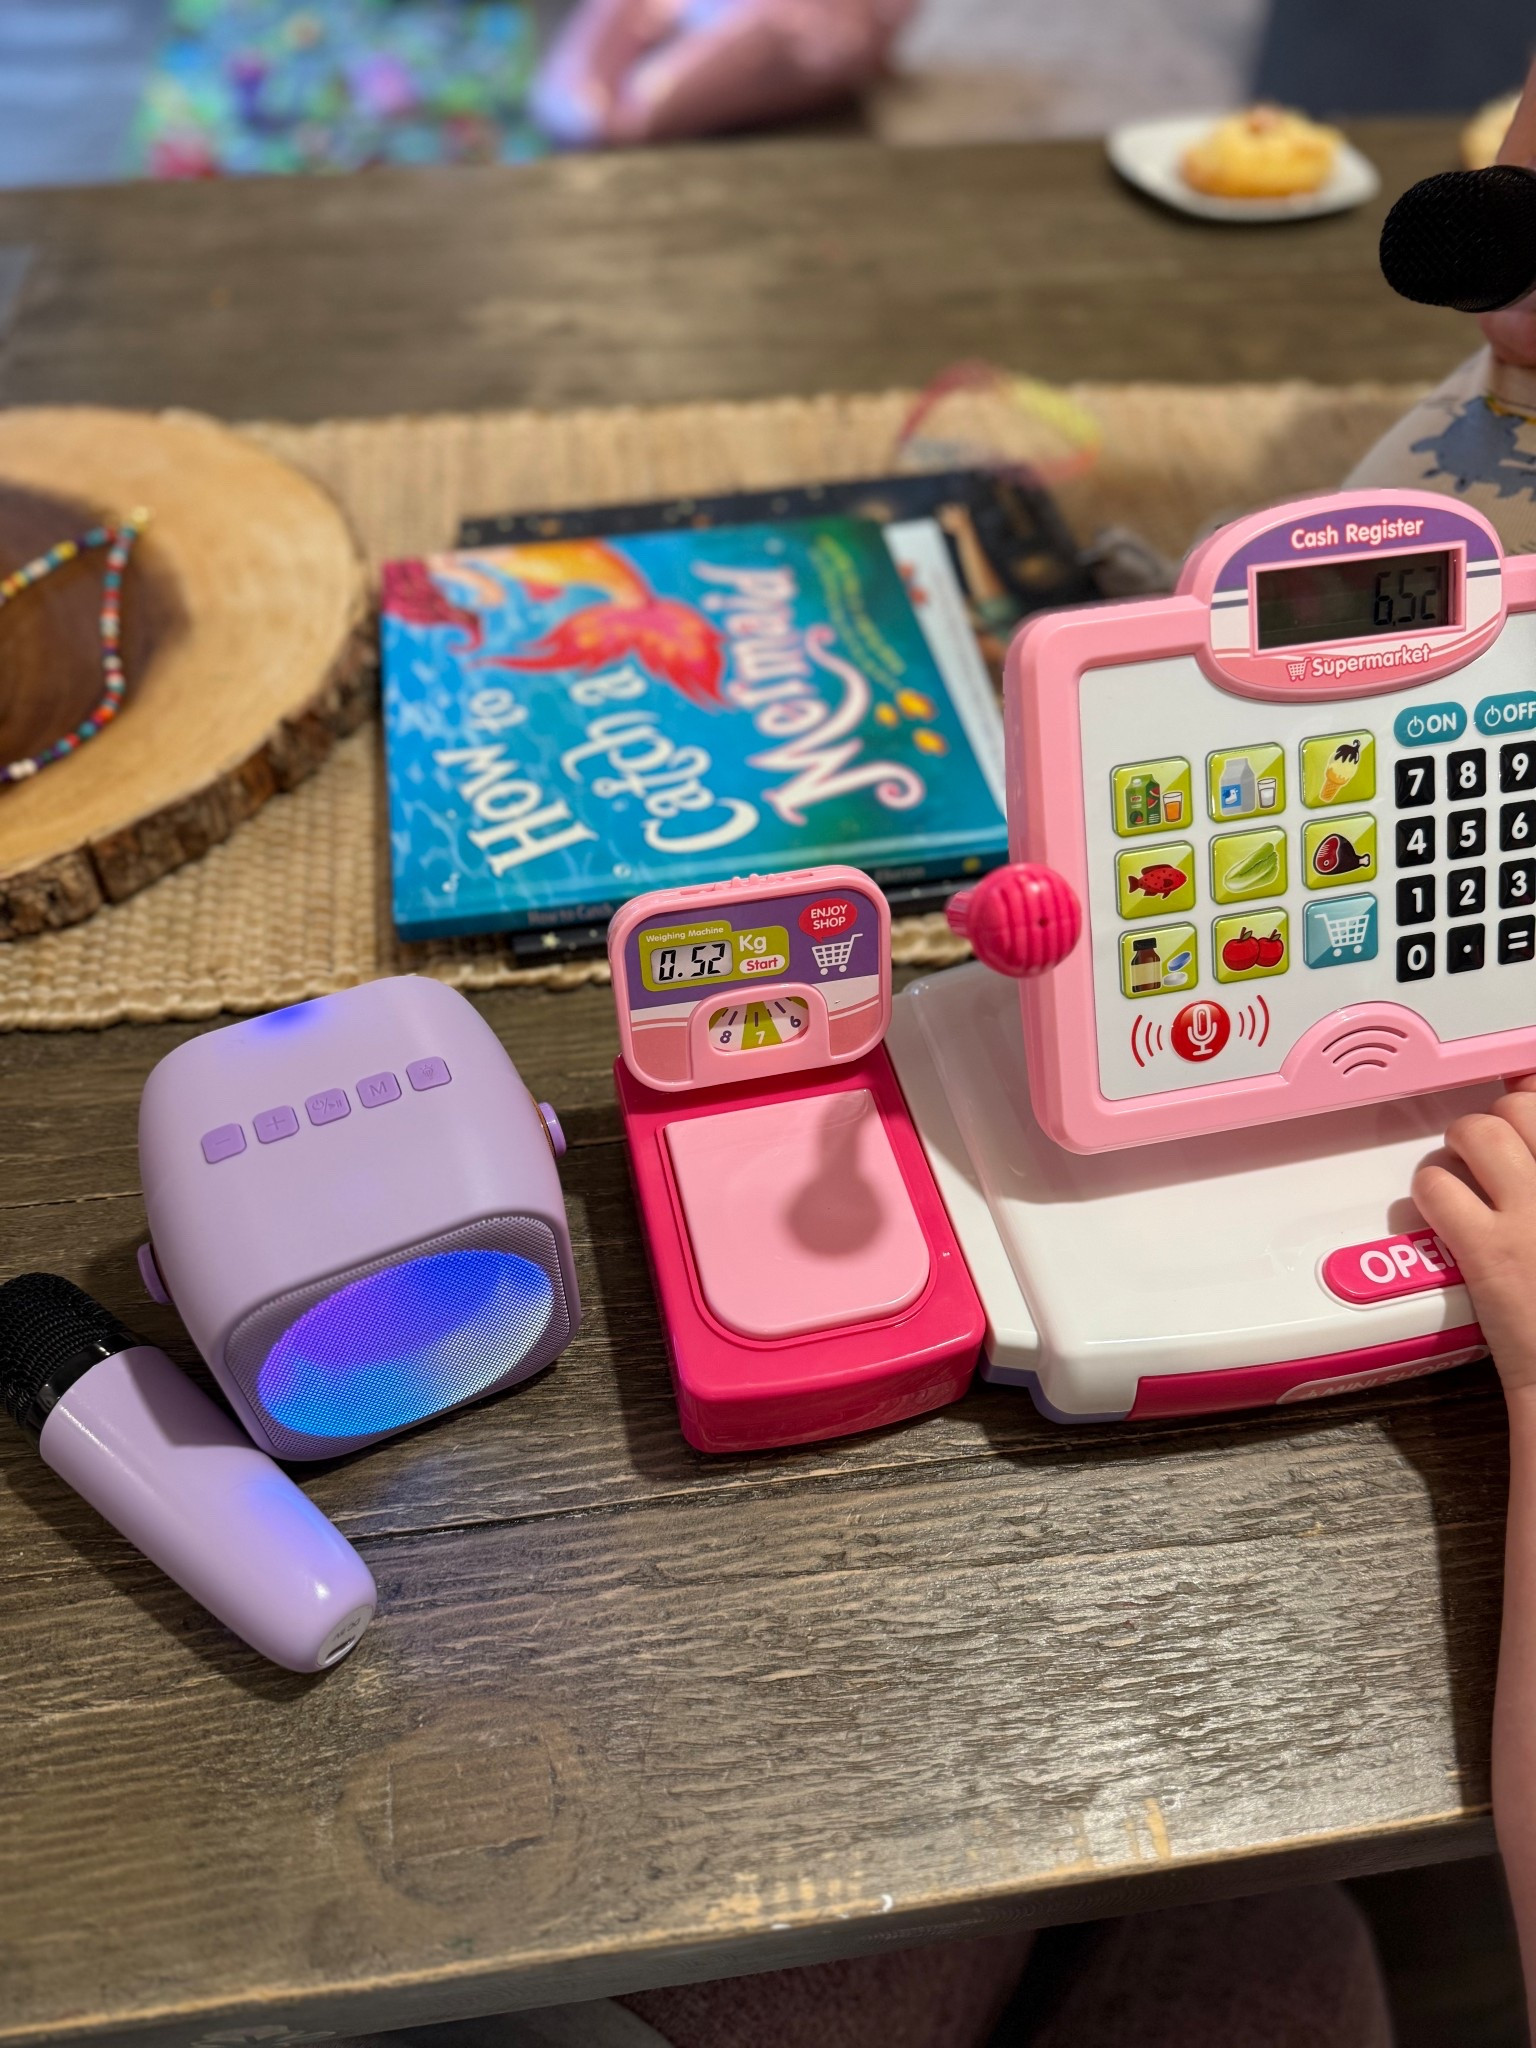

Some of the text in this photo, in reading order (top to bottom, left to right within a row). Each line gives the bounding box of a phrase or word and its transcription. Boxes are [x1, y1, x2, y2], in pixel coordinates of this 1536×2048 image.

[1291, 518, 1424, 549] Cash Register
[1312, 644, 1430, 678] Supermarket
[690, 559, 926, 827] Mermaid
[1426, 712, 1457, 734] ON
[1503, 701, 1536, 723] OFF
[560, 664, 759, 854] Catch a
[1407, 752, 1529, 797] 7 8 9
[1406, 811, 1529, 855] 4 5 6
[1411, 870, 1528, 914] 1 2 3
[810, 903, 849, 919] ENJOY
[812, 916, 847, 931] SHOP
[645, 926, 724, 943] Weighing Machine
[739, 934, 767, 954] Kg
[658, 943, 726, 981] 0.52
[746, 957, 778, 972] Start
[1406, 943, 1427, 972] 0
[719, 1030, 732, 1044] 8
[755, 1031, 766, 1045] 7
[368, 1081, 388, 1097] M
